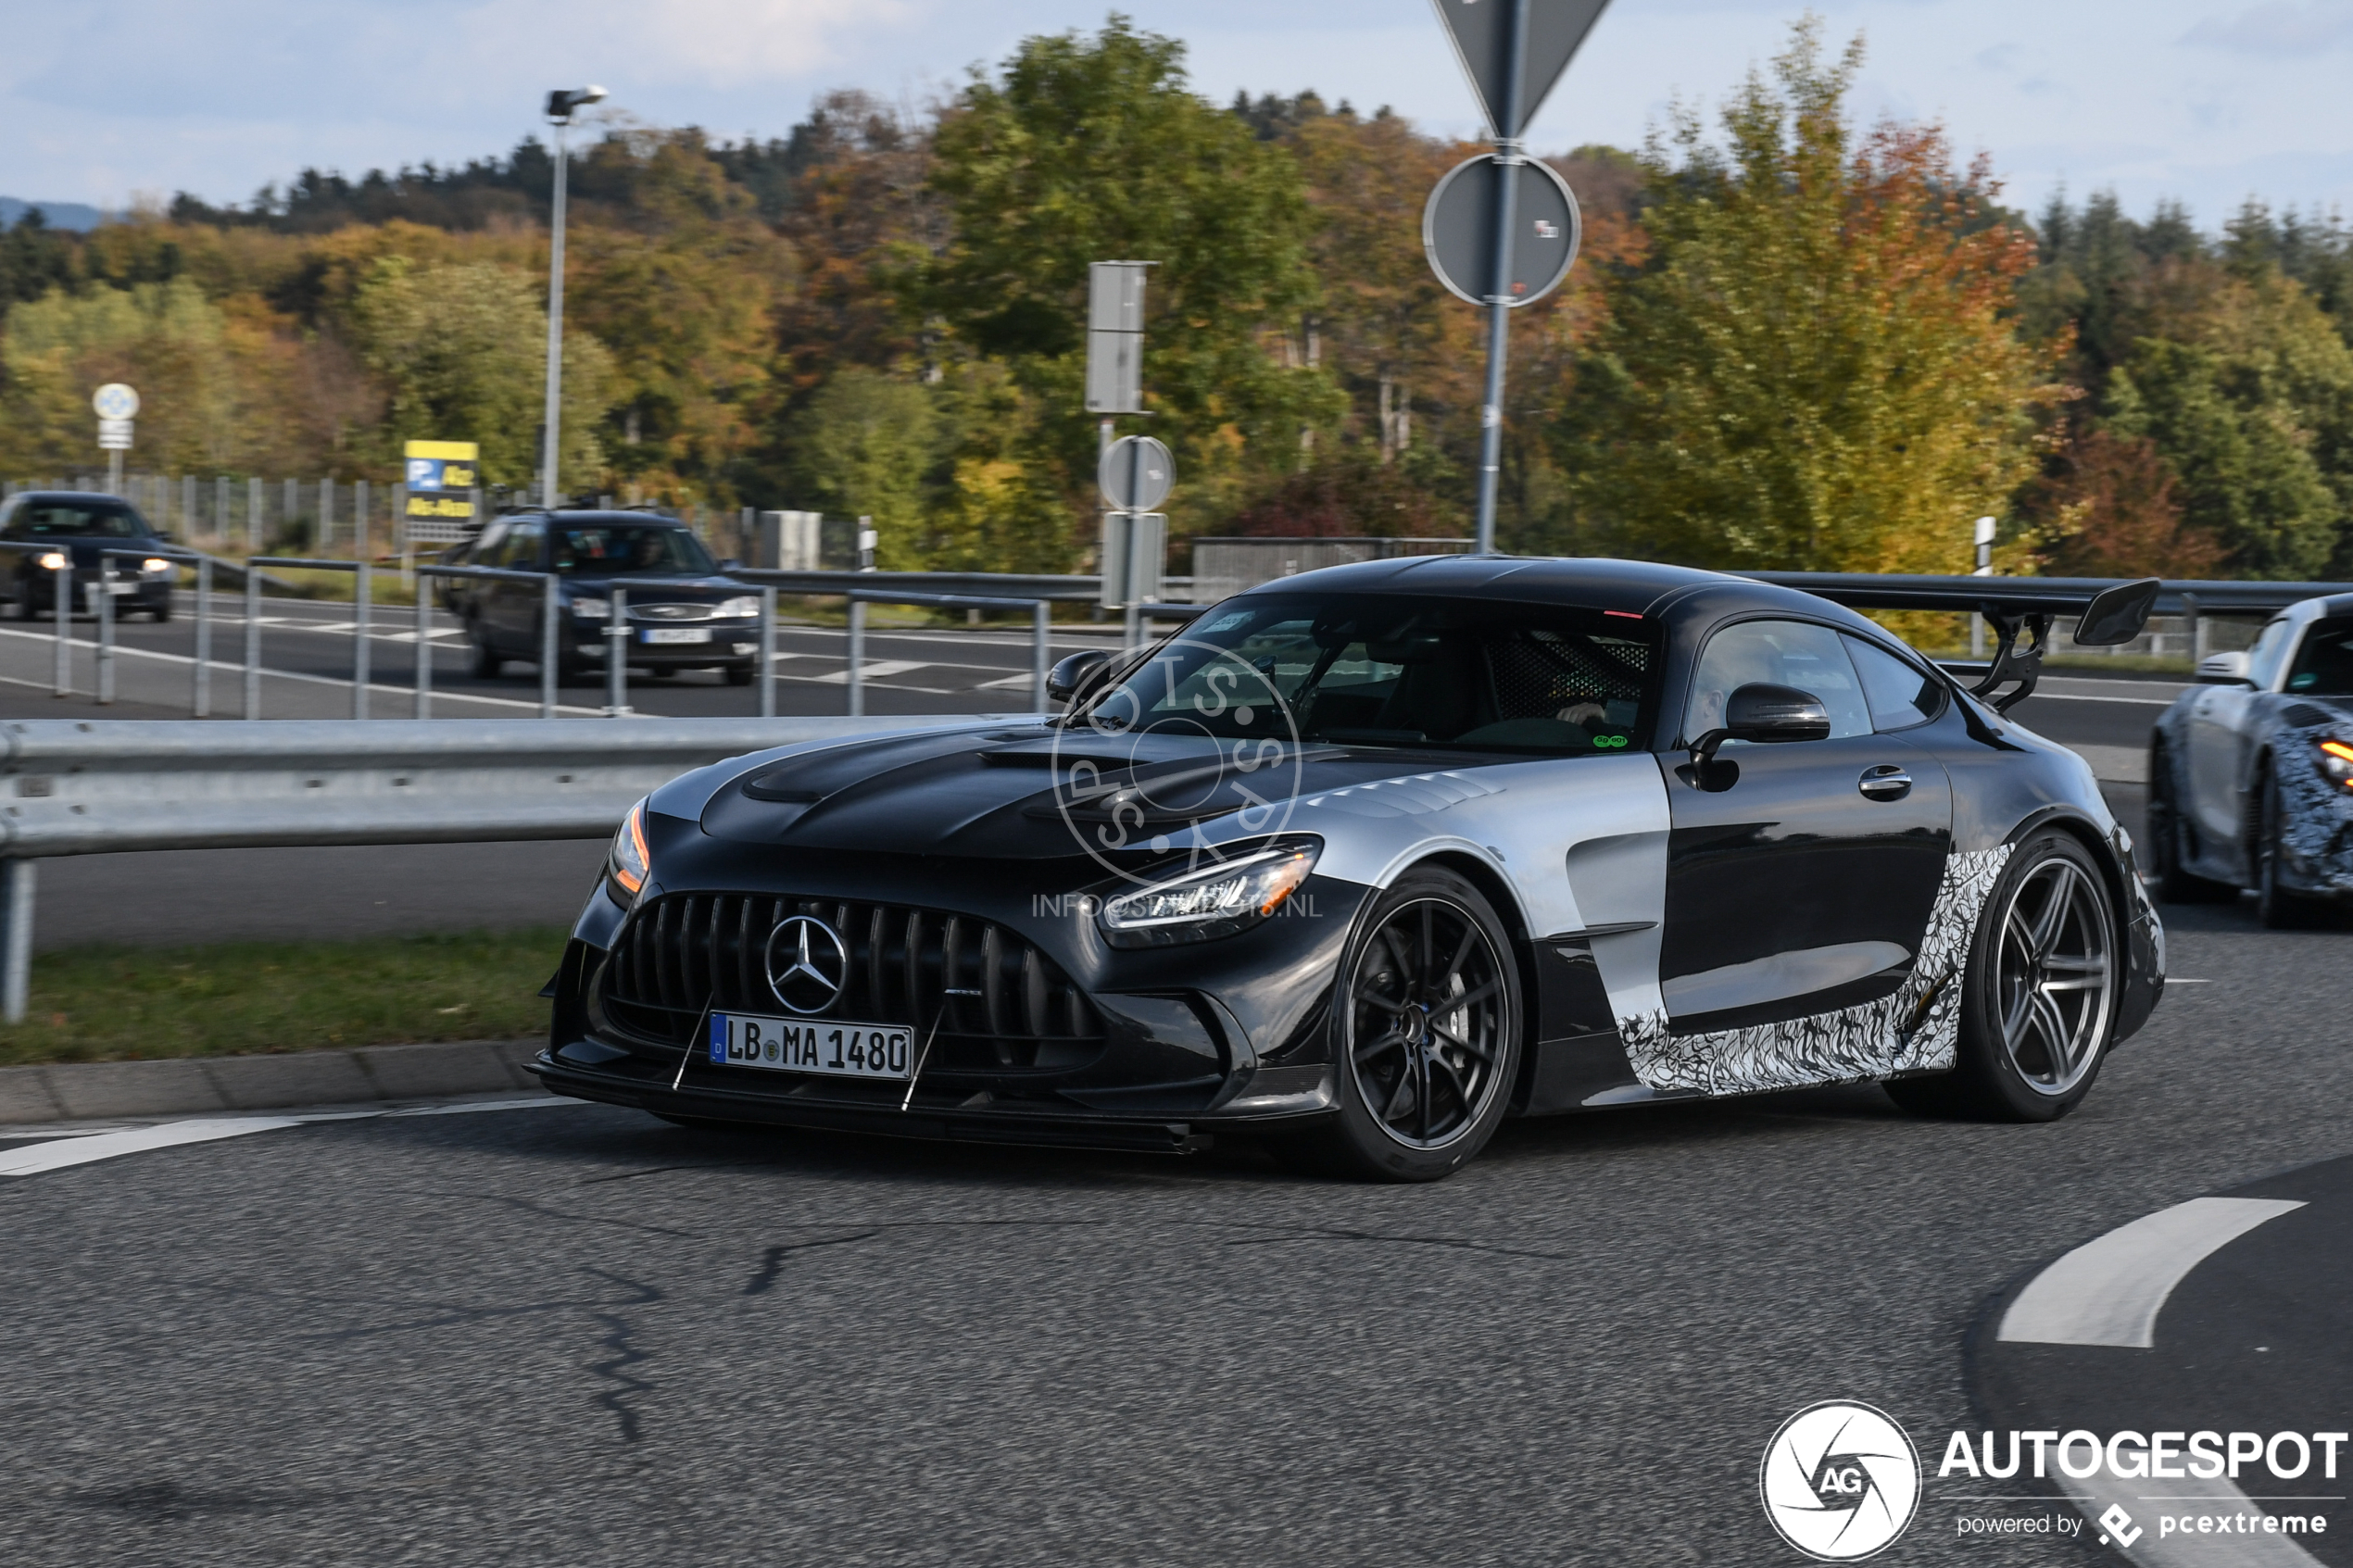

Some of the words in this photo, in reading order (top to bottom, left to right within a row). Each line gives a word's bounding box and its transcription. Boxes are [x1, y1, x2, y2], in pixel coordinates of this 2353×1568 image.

[714, 1042, 722, 1054] D
[727, 1020, 761, 1060] LB
[782, 1025, 818, 1066] MA
[827, 1029, 907, 1073] 1480
